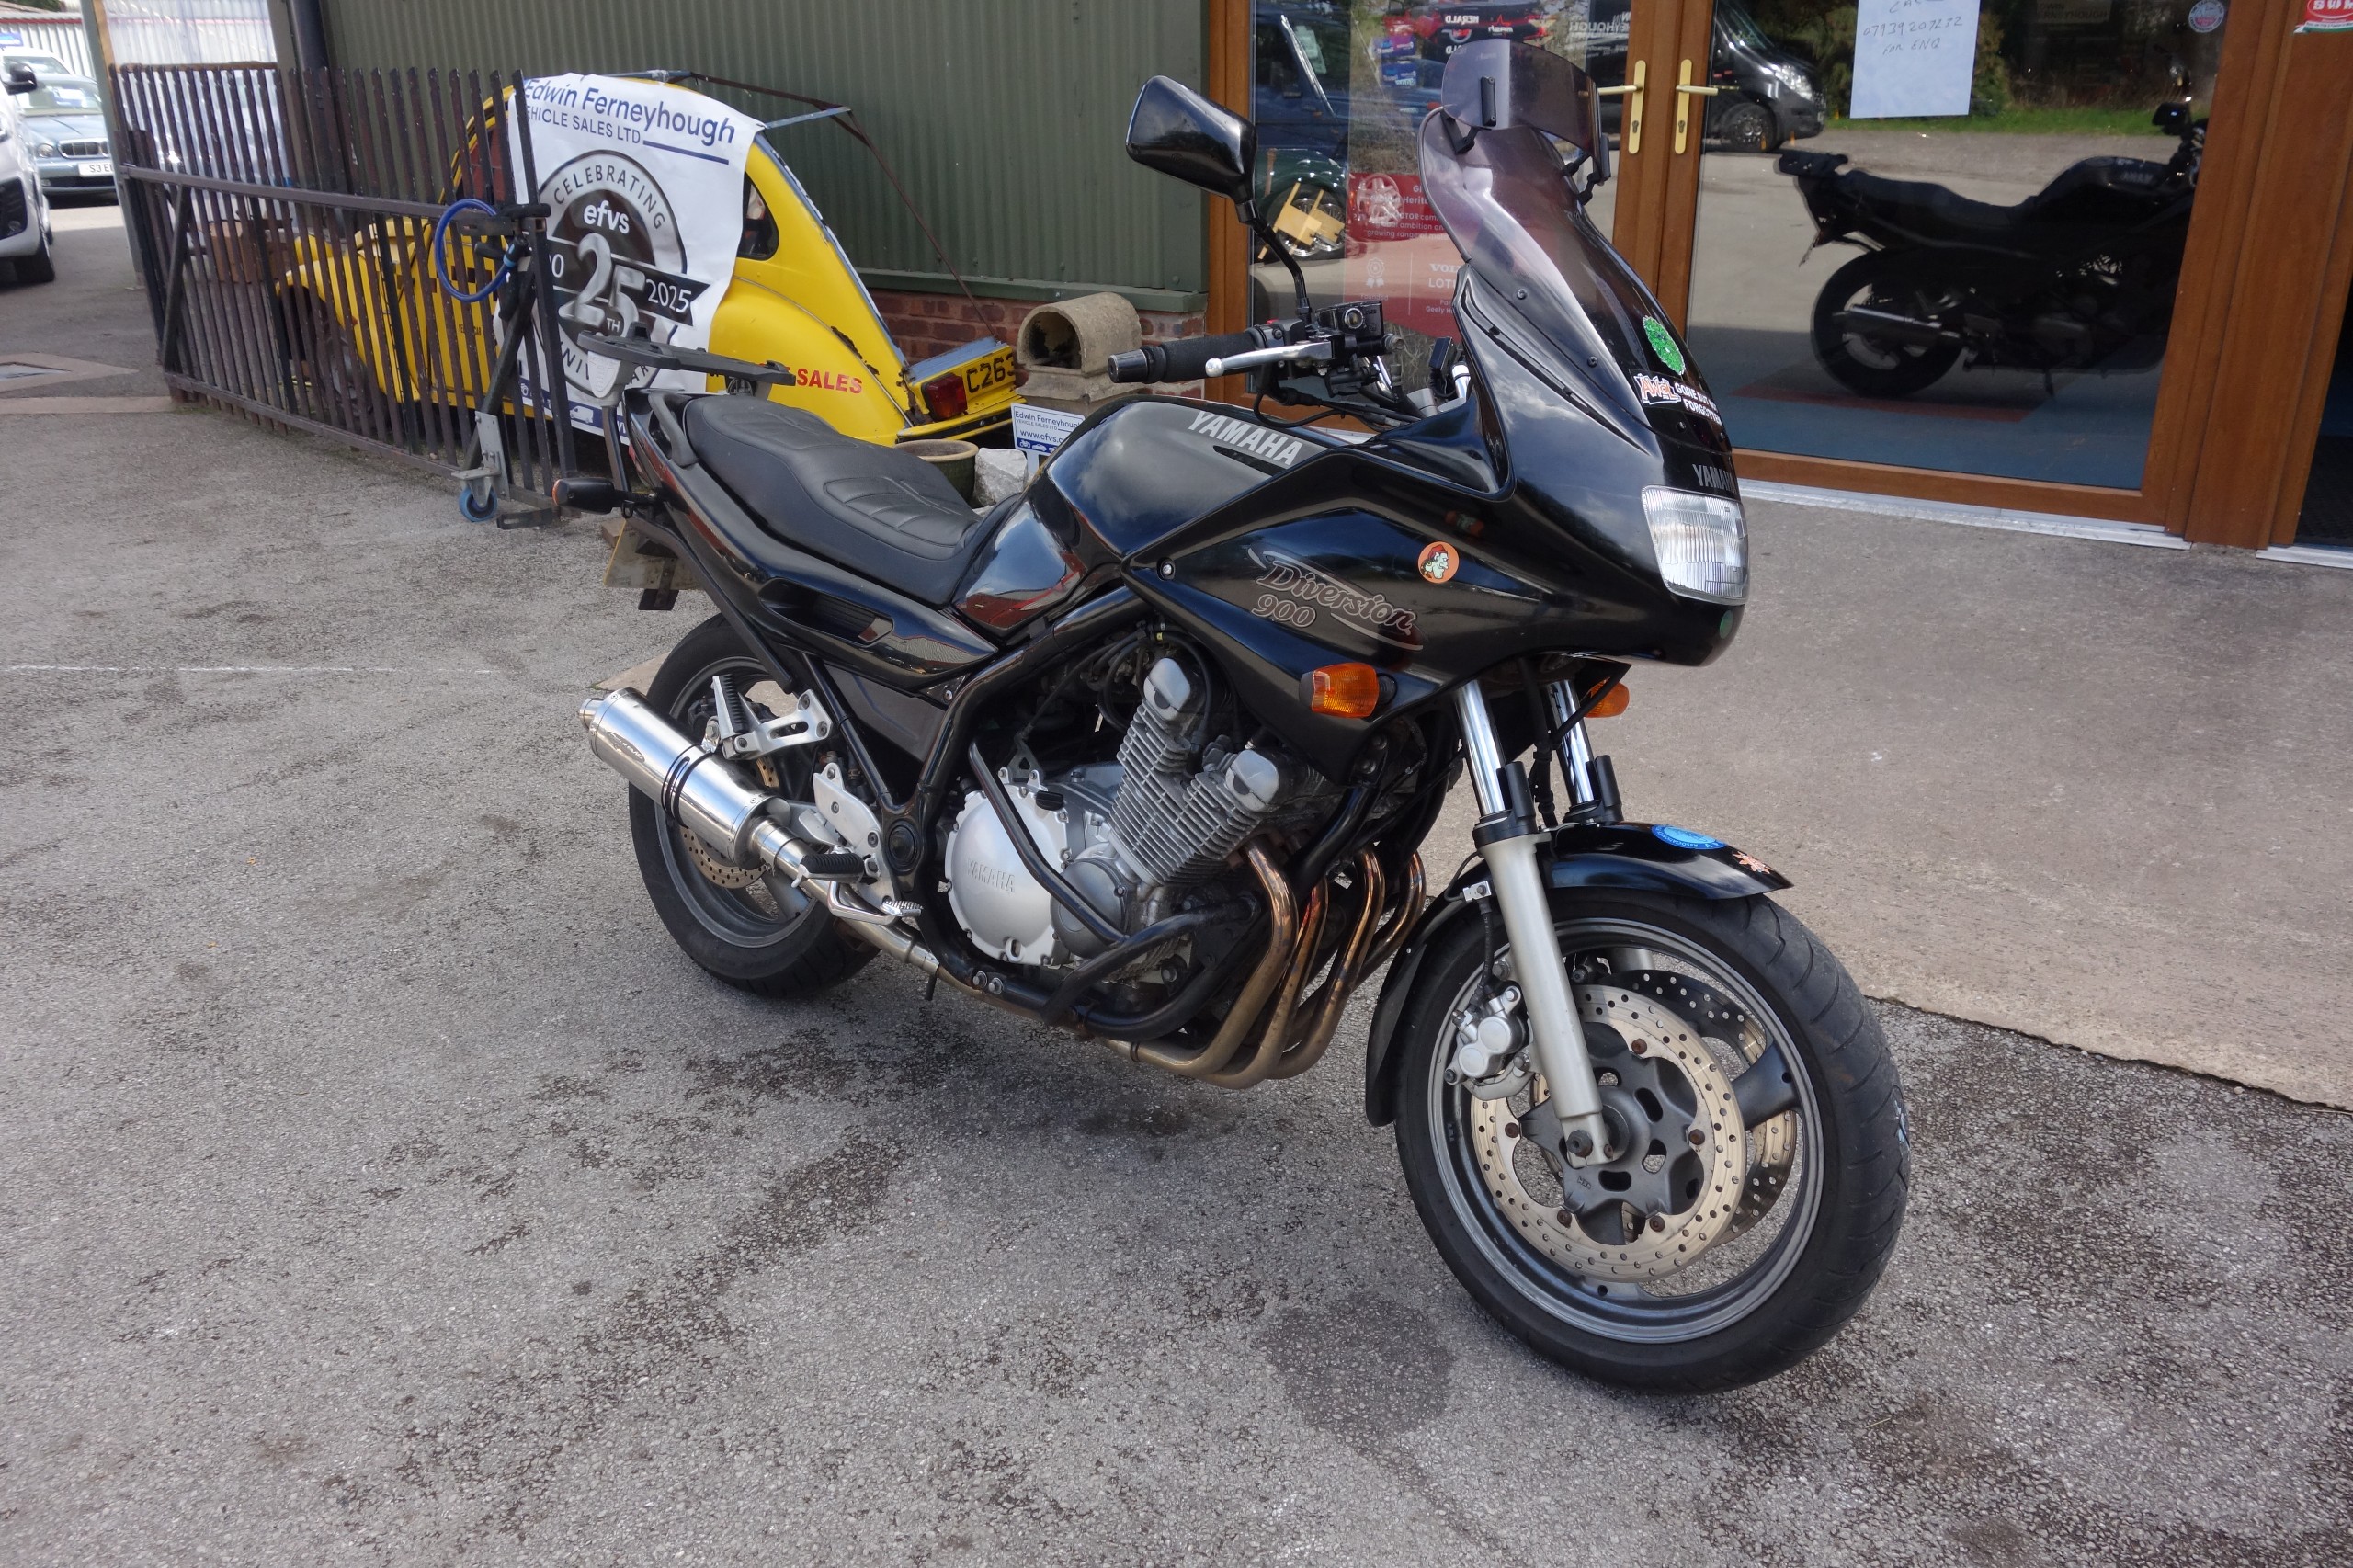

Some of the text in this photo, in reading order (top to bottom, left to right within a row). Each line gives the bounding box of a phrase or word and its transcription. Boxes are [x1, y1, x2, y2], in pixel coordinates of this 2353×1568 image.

[524, 79, 735, 146] Edwin Ferneyhough
[527, 105, 641, 143] EHICLE SALES LTD
[89, 164, 101, 172] S3
[554, 165, 665, 229] CELEBRATING
[584, 200, 630, 234] efvs
[1400, 221, 1432, 230] ambition
[1367, 229, 1395, 238] growing
[558, 232, 646, 335] 25
[646, 279, 691, 313] 2025
[607, 317, 620, 332] TH
[1426, 306, 1445, 314] Geely
[797, 368, 862, 393] SALES
[1674, 382, 1698, 399] GONE
[1015, 410, 1036, 421] Edwin
[1683, 398, 1722, 426] FORGOTTEN
[1020, 429, 1063, 444] www.efvs.c
[1188, 410, 1302, 466] YAMAHA
[1251, 594, 1317, 628] 900
[1256, 560, 1416, 635] Diversion
[967, 858, 1016, 892] YAMAHA
